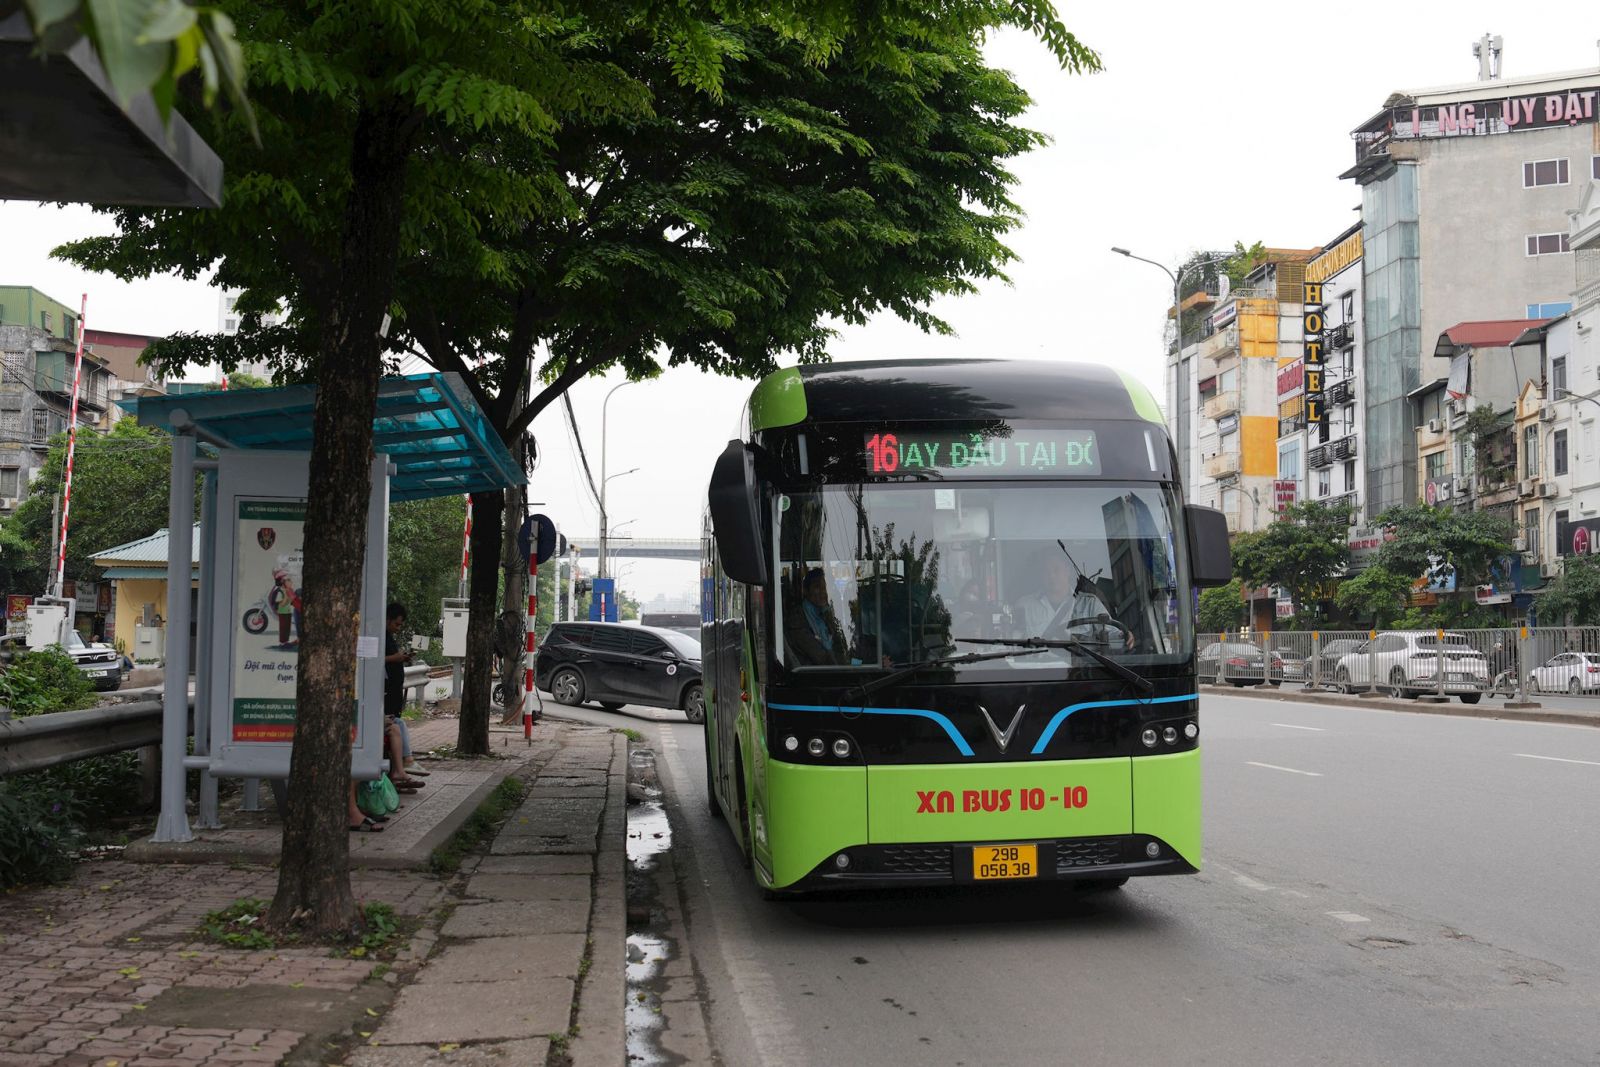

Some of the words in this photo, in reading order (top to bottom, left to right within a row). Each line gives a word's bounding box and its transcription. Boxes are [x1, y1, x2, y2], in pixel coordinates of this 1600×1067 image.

[1545, 91, 1597, 127] ĐẠT
[1305, 284, 1322, 422] HOTEL
[866, 433, 900, 473] 16
[899, 441, 940, 468] AY
[1015, 441, 1057, 471] TẠI
[244, 660, 259, 672] Đội
[277, 661, 292, 671] cho
[962, 788, 1012, 813] BUS
[1020, 787, 1045, 811] 10
[1063, 785, 1088, 809] 10
[991, 847, 1019, 862] 29B
[980, 862, 1031, 877] 058.38
